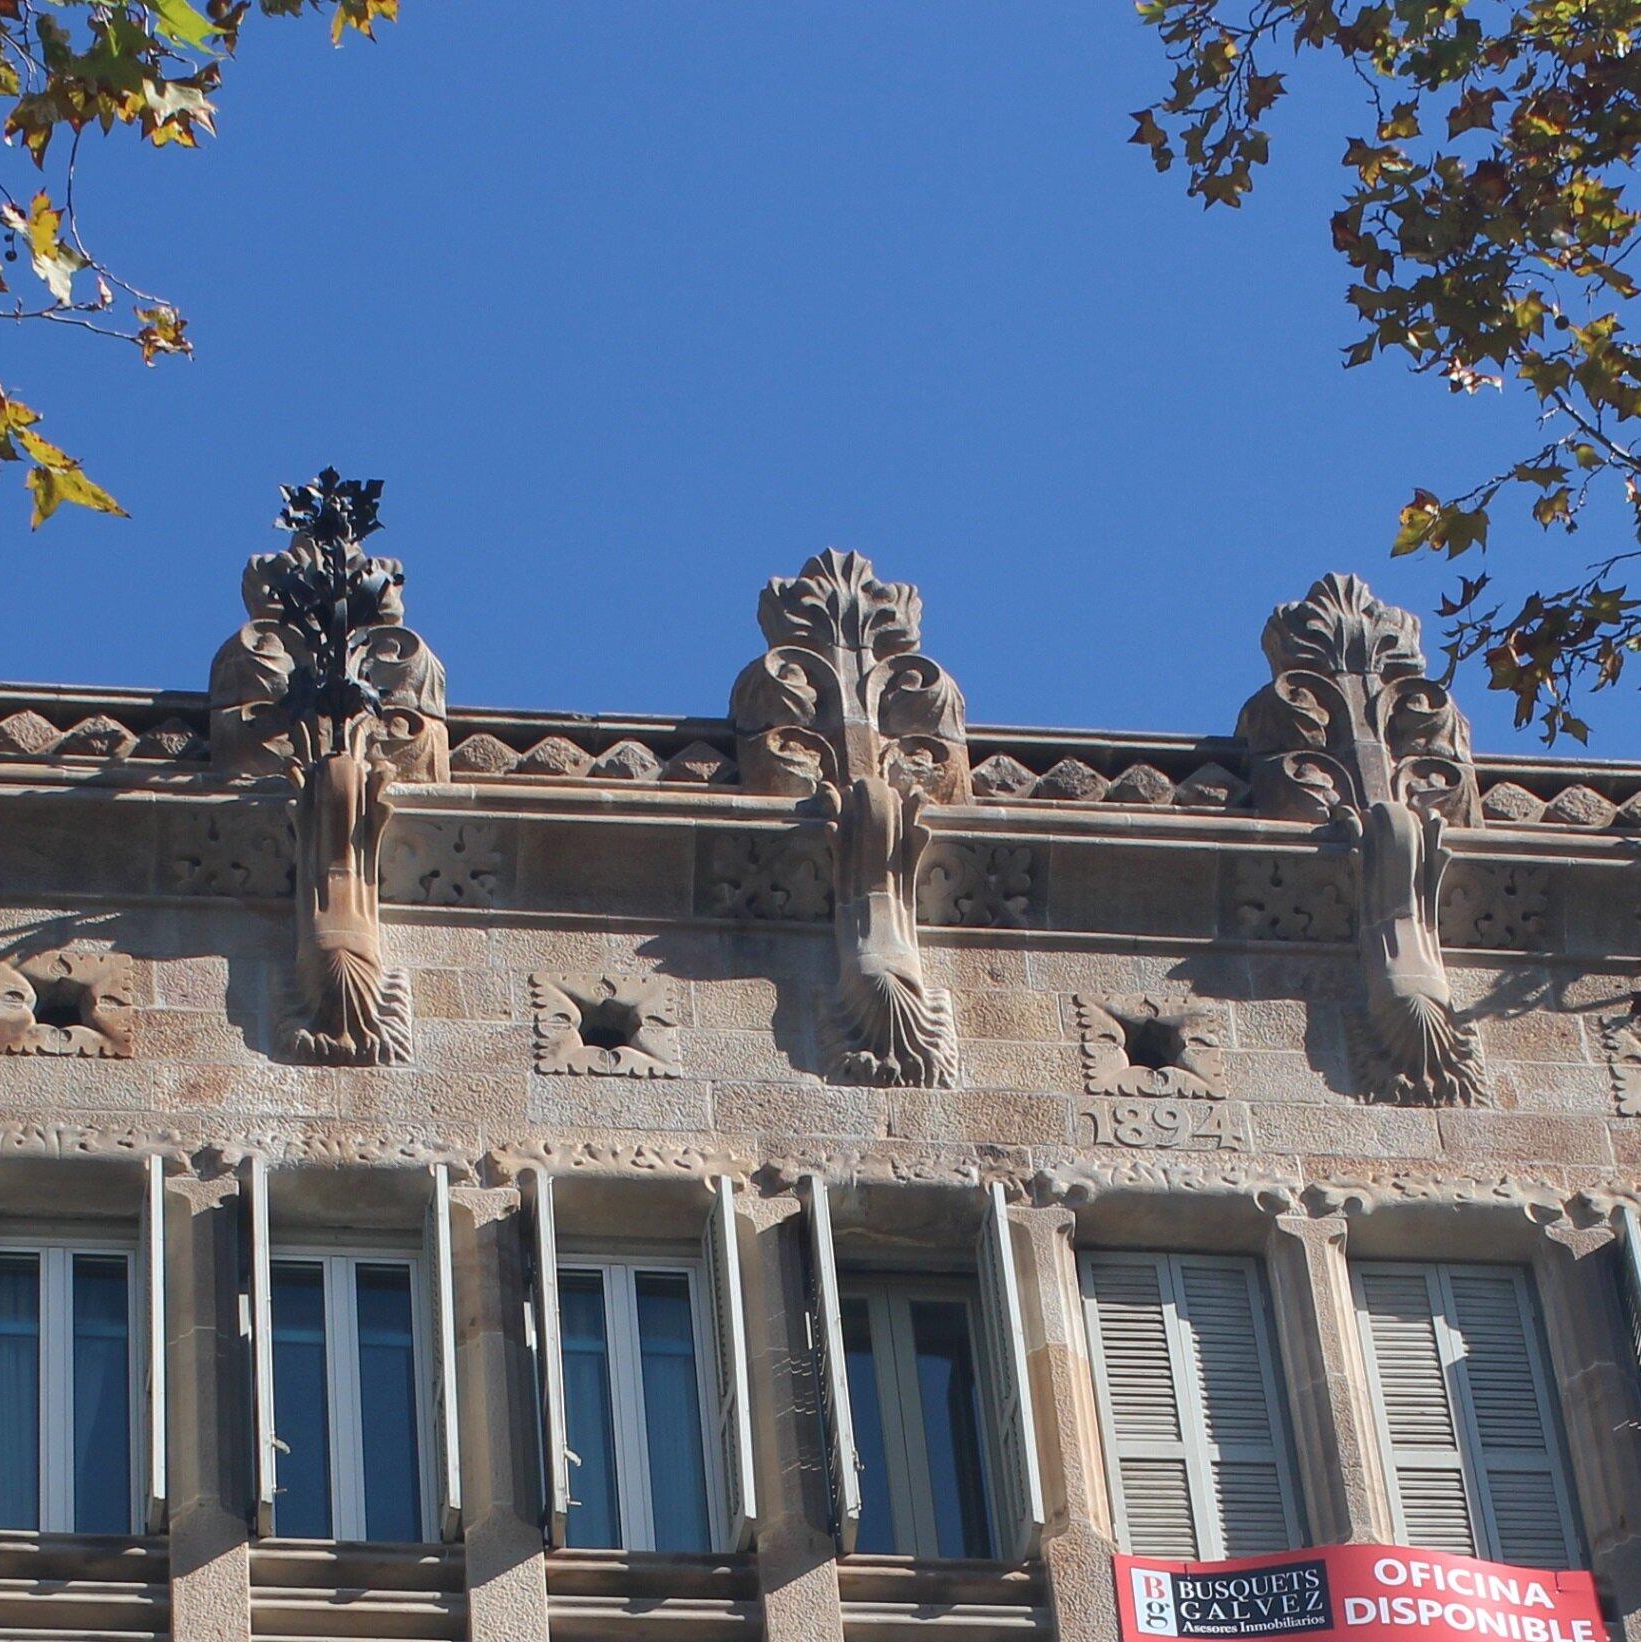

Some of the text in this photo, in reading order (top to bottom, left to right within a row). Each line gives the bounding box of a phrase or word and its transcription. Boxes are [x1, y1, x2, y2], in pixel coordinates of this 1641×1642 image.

[1079, 1104, 1243, 1151] 1894
[1177, 1568, 1320, 1602] BUSQUETS
[1374, 1558, 1555, 1609] OFICINA
[1180, 1591, 1323, 1620] GALVEZ
[1182, 1615, 1325, 1634] Asesores Inmobiliarios
